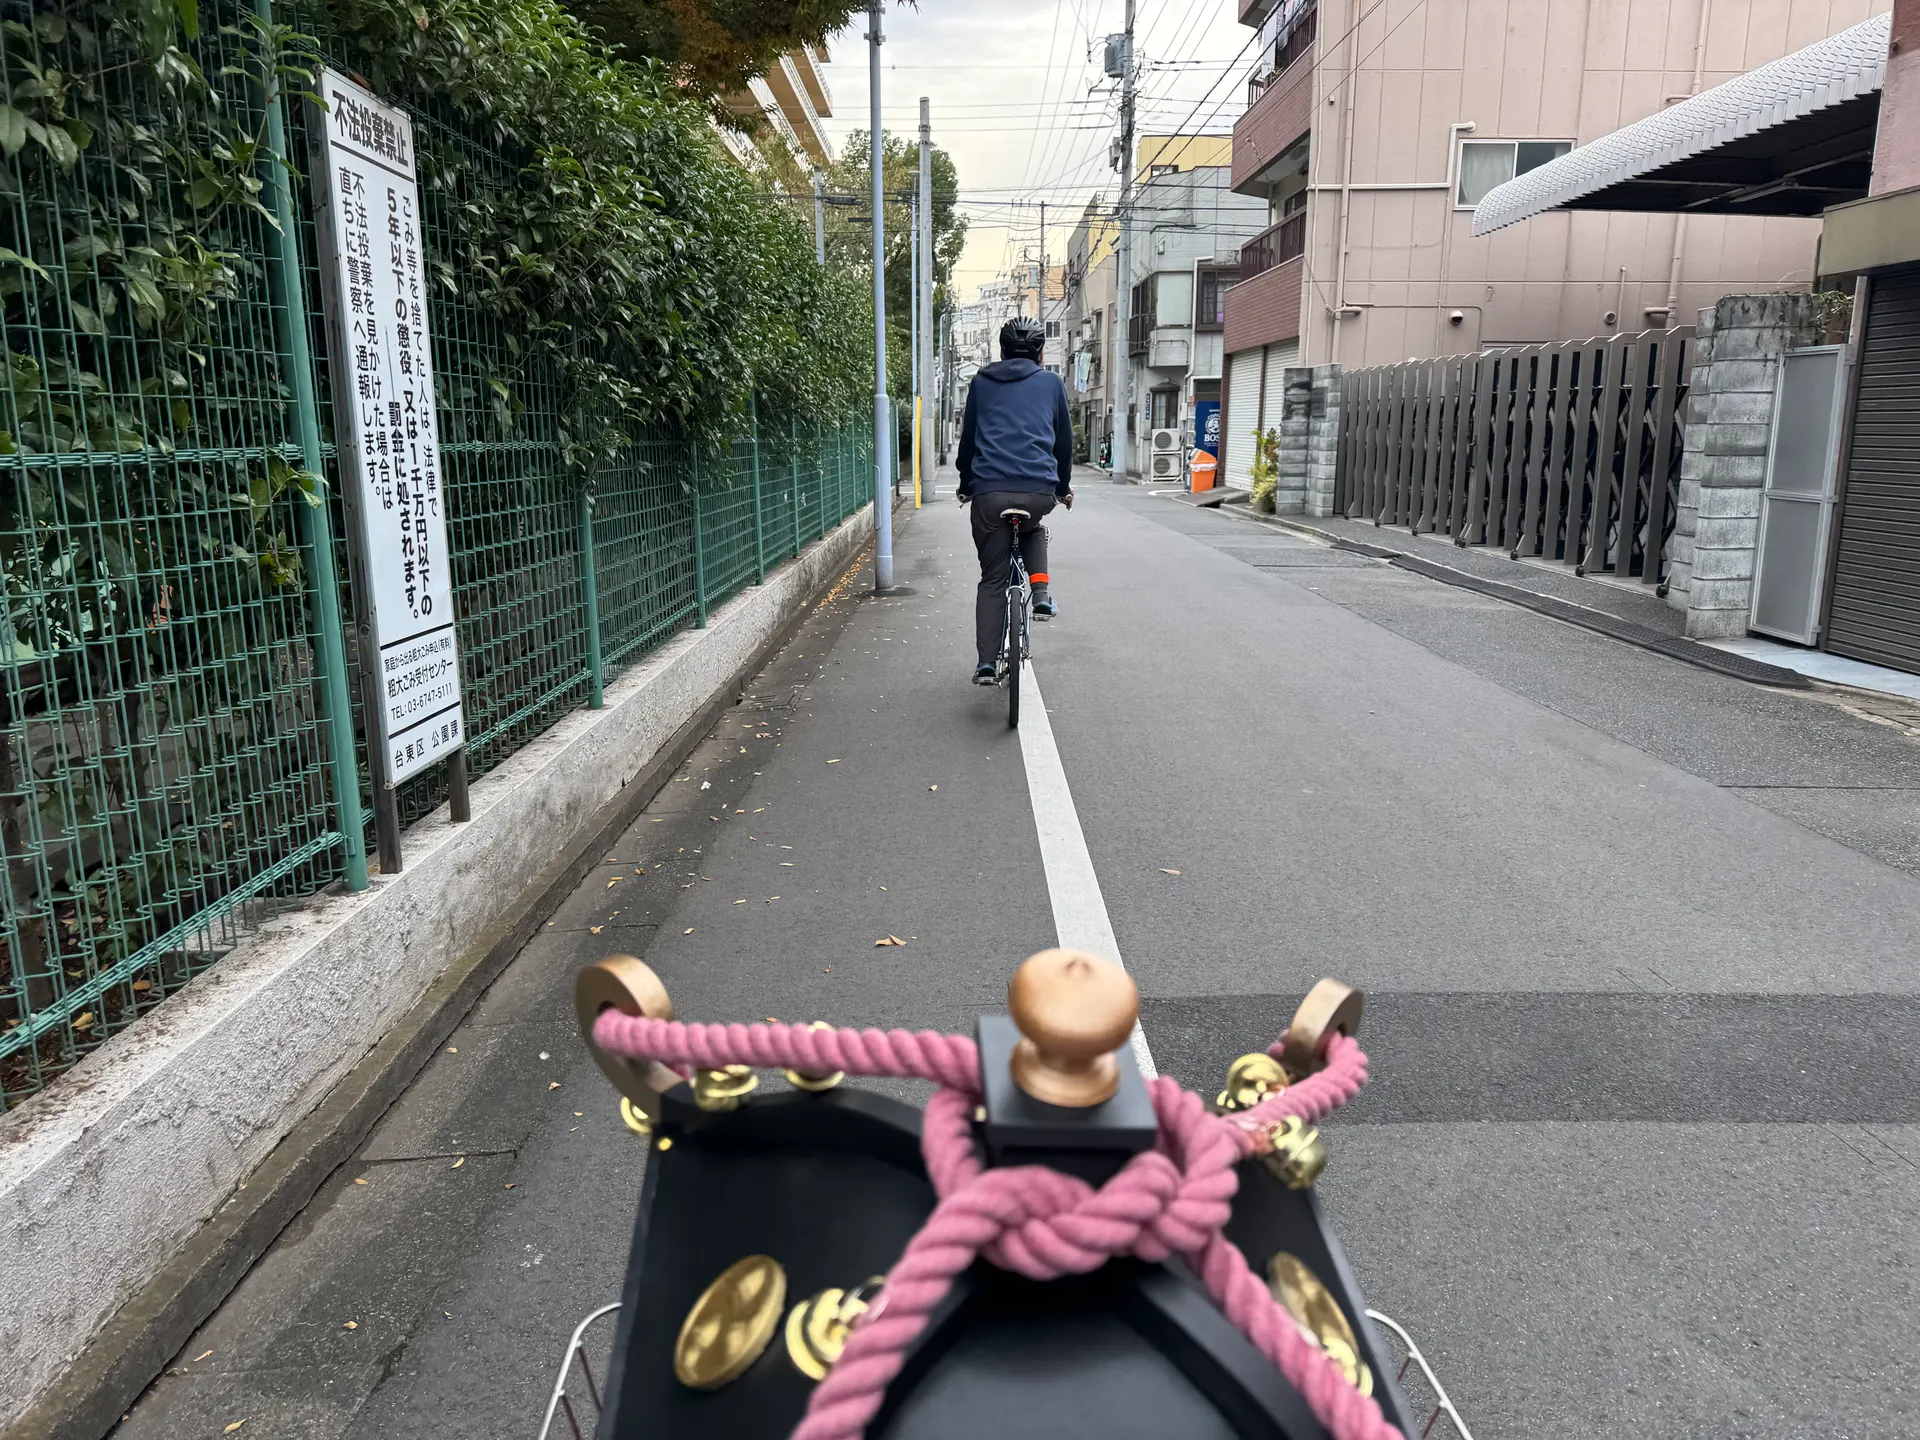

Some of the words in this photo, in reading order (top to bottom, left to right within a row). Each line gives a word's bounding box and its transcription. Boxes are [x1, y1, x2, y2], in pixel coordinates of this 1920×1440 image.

[332, 89, 409, 168] 不法投棄禁止
[339, 166, 381, 496] 直ちに警察へ通報します。
[352, 171, 394, 510] 不法投棄を見かけた場合は
[402, 195, 438, 517] ごみ等を捨てた人は、法律で
[388, 401, 419, 619] 罰金に処されます。
[387, 658, 453, 698] 粗大ごみ受付センター
[395, 738, 425, 769] 台東区
[431, 719, 459, 749] 公園課
